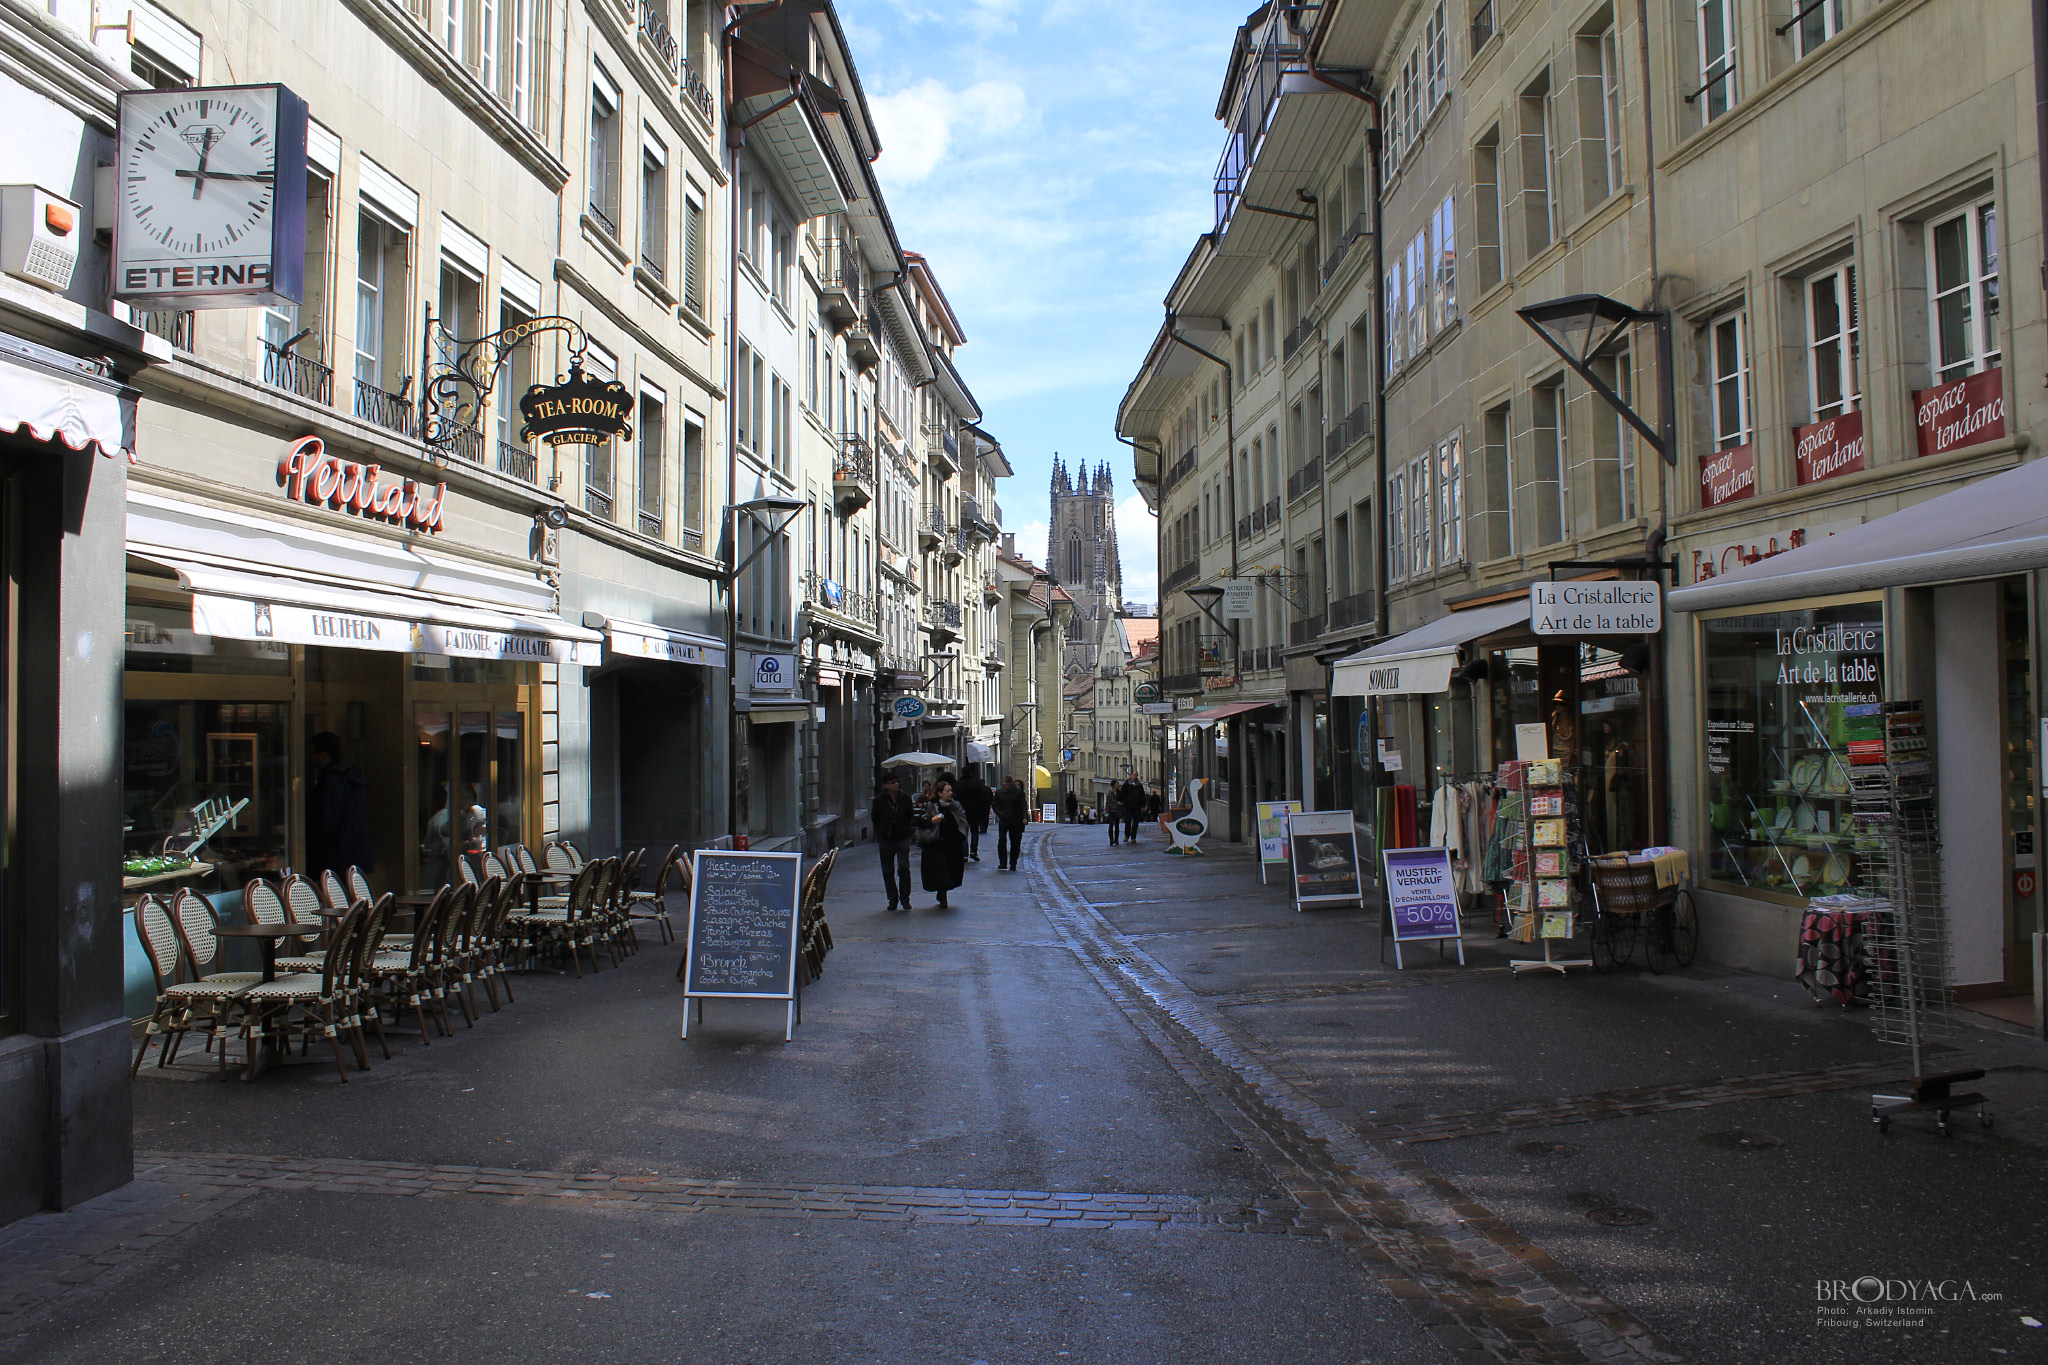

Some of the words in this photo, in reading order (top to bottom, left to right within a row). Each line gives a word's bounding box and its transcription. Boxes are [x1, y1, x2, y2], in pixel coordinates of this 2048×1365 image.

[126, 263, 271, 288] ETERNA
[535, 398, 619, 419] TEA-ROOM
[1918, 382, 1966, 431] espace
[553, 433, 598, 444] GLACIER
[1797, 421, 1835, 464] espace
[1812, 436, 1865, 480] tendanc
[1702, 452, 1733, 489] espace
[278, 435, 447, 531] Perriard
[1537, 588, 1557, 605] La
[1563, 586, 1655, 605] Cristallerie
[1539, 615, 1568, 630] Art
[1572, 614, 1592, 629] de
[1597, 614, 1611, 629] la
[1615, 613, 1655, 629] table
[499, 637, 553, 657] CHOCOLATIER
[1776, 628, 1791, 655] La
[1793, 621, 1876, 655] Cristallerie
[756, 667, 782, 684] fara
[1369, 667, 1400, 691] SCOOTER
[1776, 662, 1800, 685] Art
[1803, 660, 1820, 683] de
[1824, 659, 1838, 683] la
[1841, 657, 1877, 682] table
[1605, 677, 1639, 693] SCOOTER
[1805, 691, 1877, 704] www.lacristallerie.ch
[896, 701, 920, 717] FASS
[1396, 867, 1442, 878] MUSTER-
[1397, 876, 1443, 886] VERKAUF
[1395, 894, 1450, 903] D'ECHANTILLONS
[1407, 904, 1453, 923] 50%
[701, 953, 748, 969] Brunch
